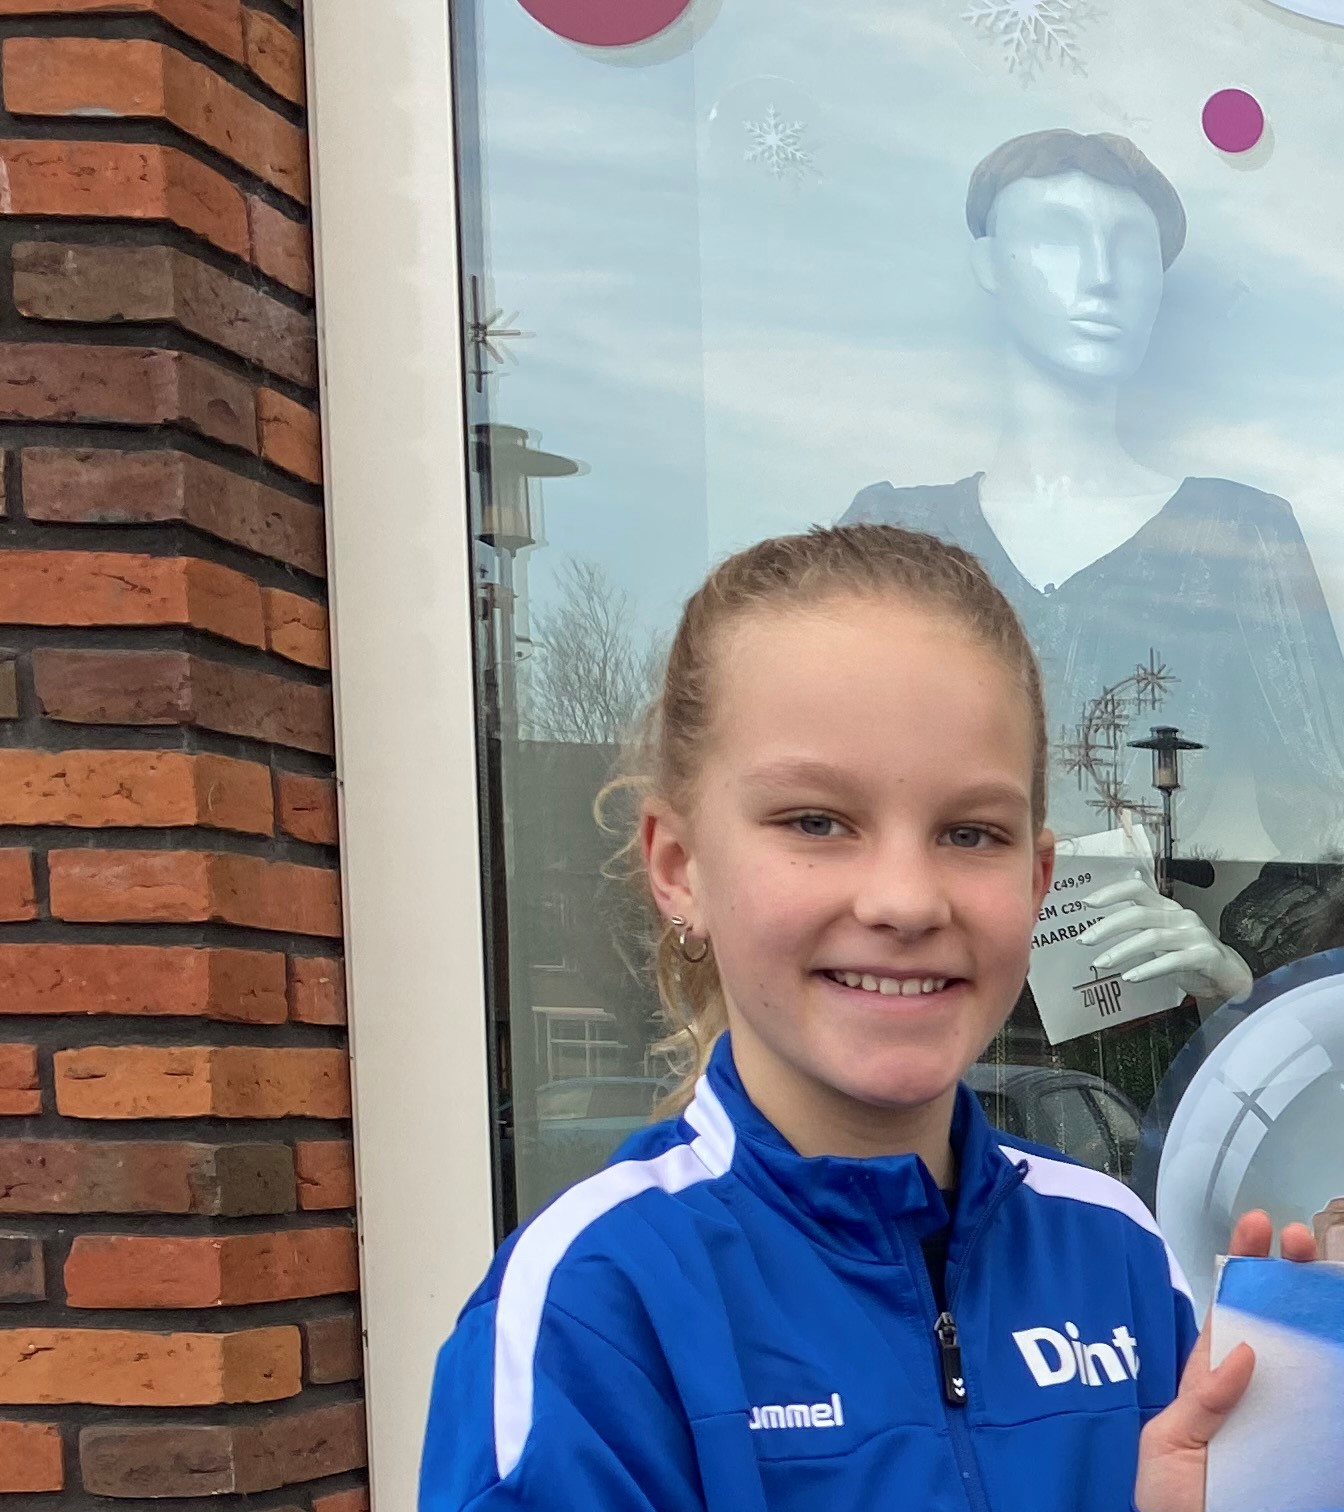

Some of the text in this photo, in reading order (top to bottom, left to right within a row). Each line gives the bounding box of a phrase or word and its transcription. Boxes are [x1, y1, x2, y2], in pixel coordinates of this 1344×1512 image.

[1038, 905, 1058, 922] EM
[1093, 980, 1122, 1017] HIP
[749, 1392, 845, 1430] ummel
